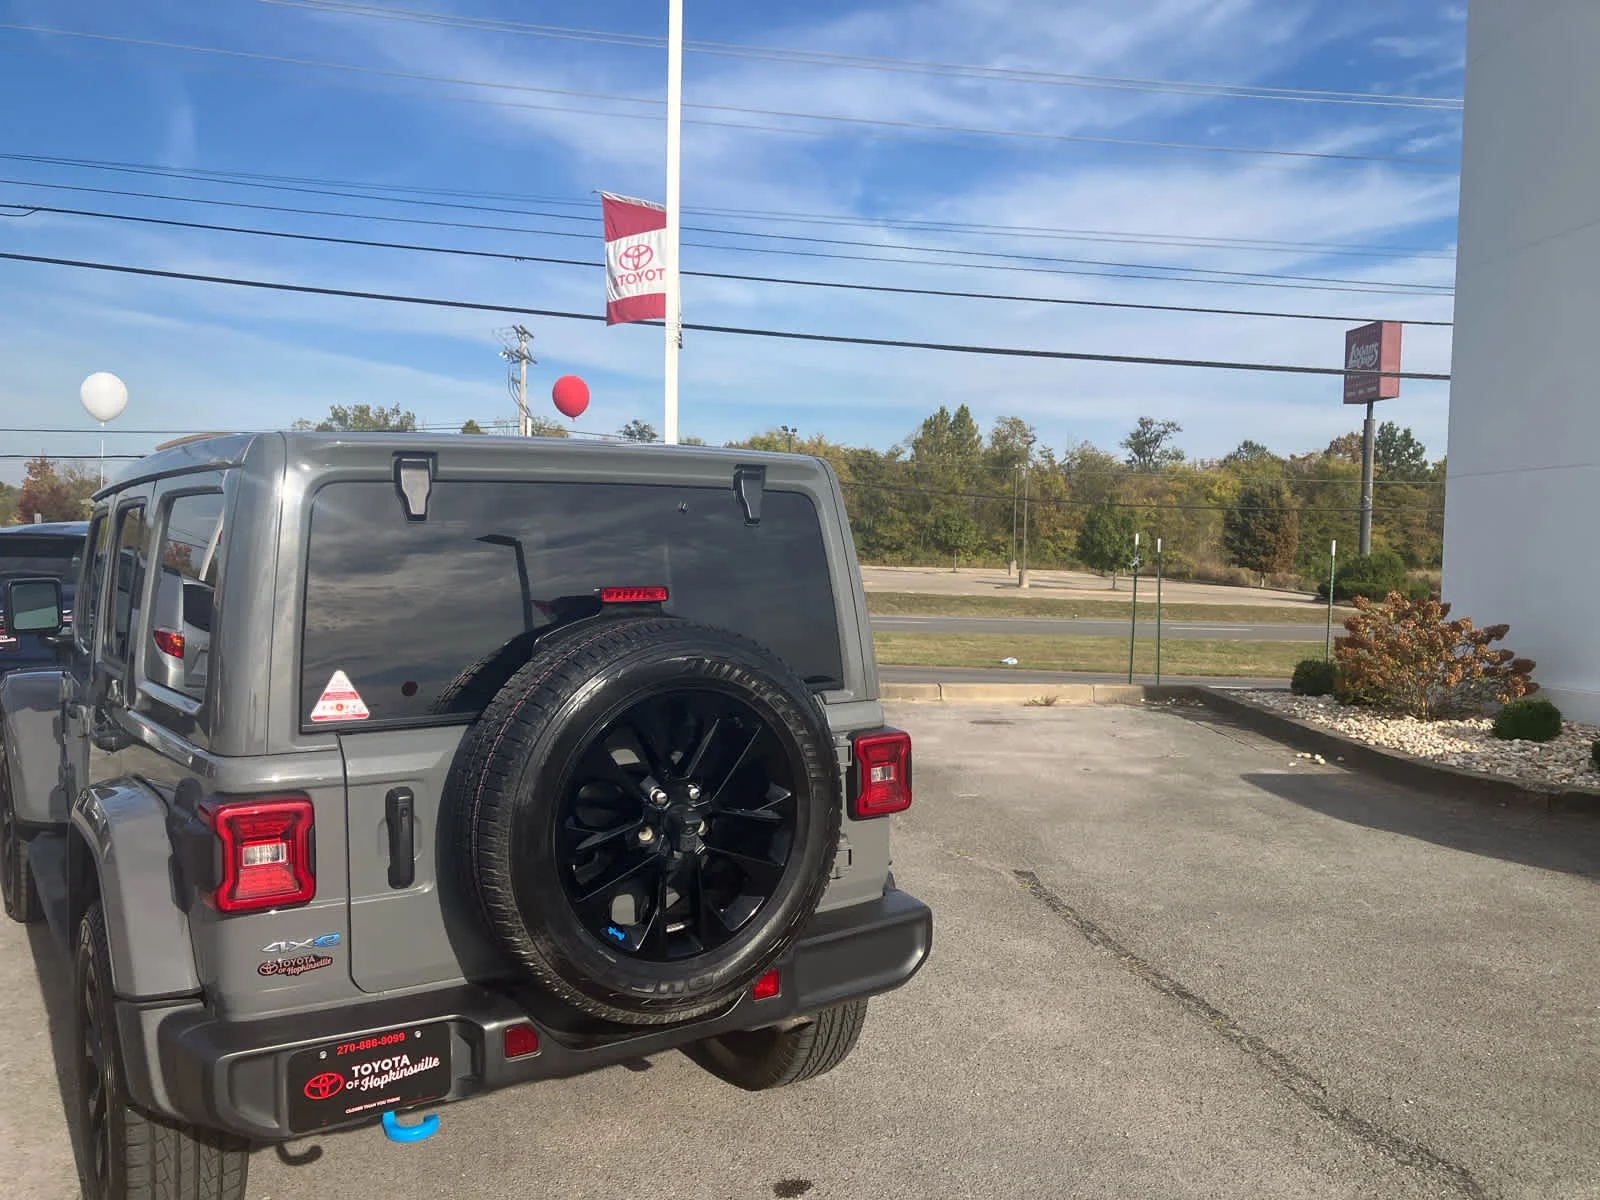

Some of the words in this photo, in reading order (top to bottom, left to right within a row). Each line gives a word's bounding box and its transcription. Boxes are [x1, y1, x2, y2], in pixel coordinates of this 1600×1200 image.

[279, 955, 315, 967] TOYOTA
[345, 1079, 360, 1090] OF
[360, 1056, 440, 1091] Hopkinsville
[352, 1054, 410, 1077] TOYOTA
